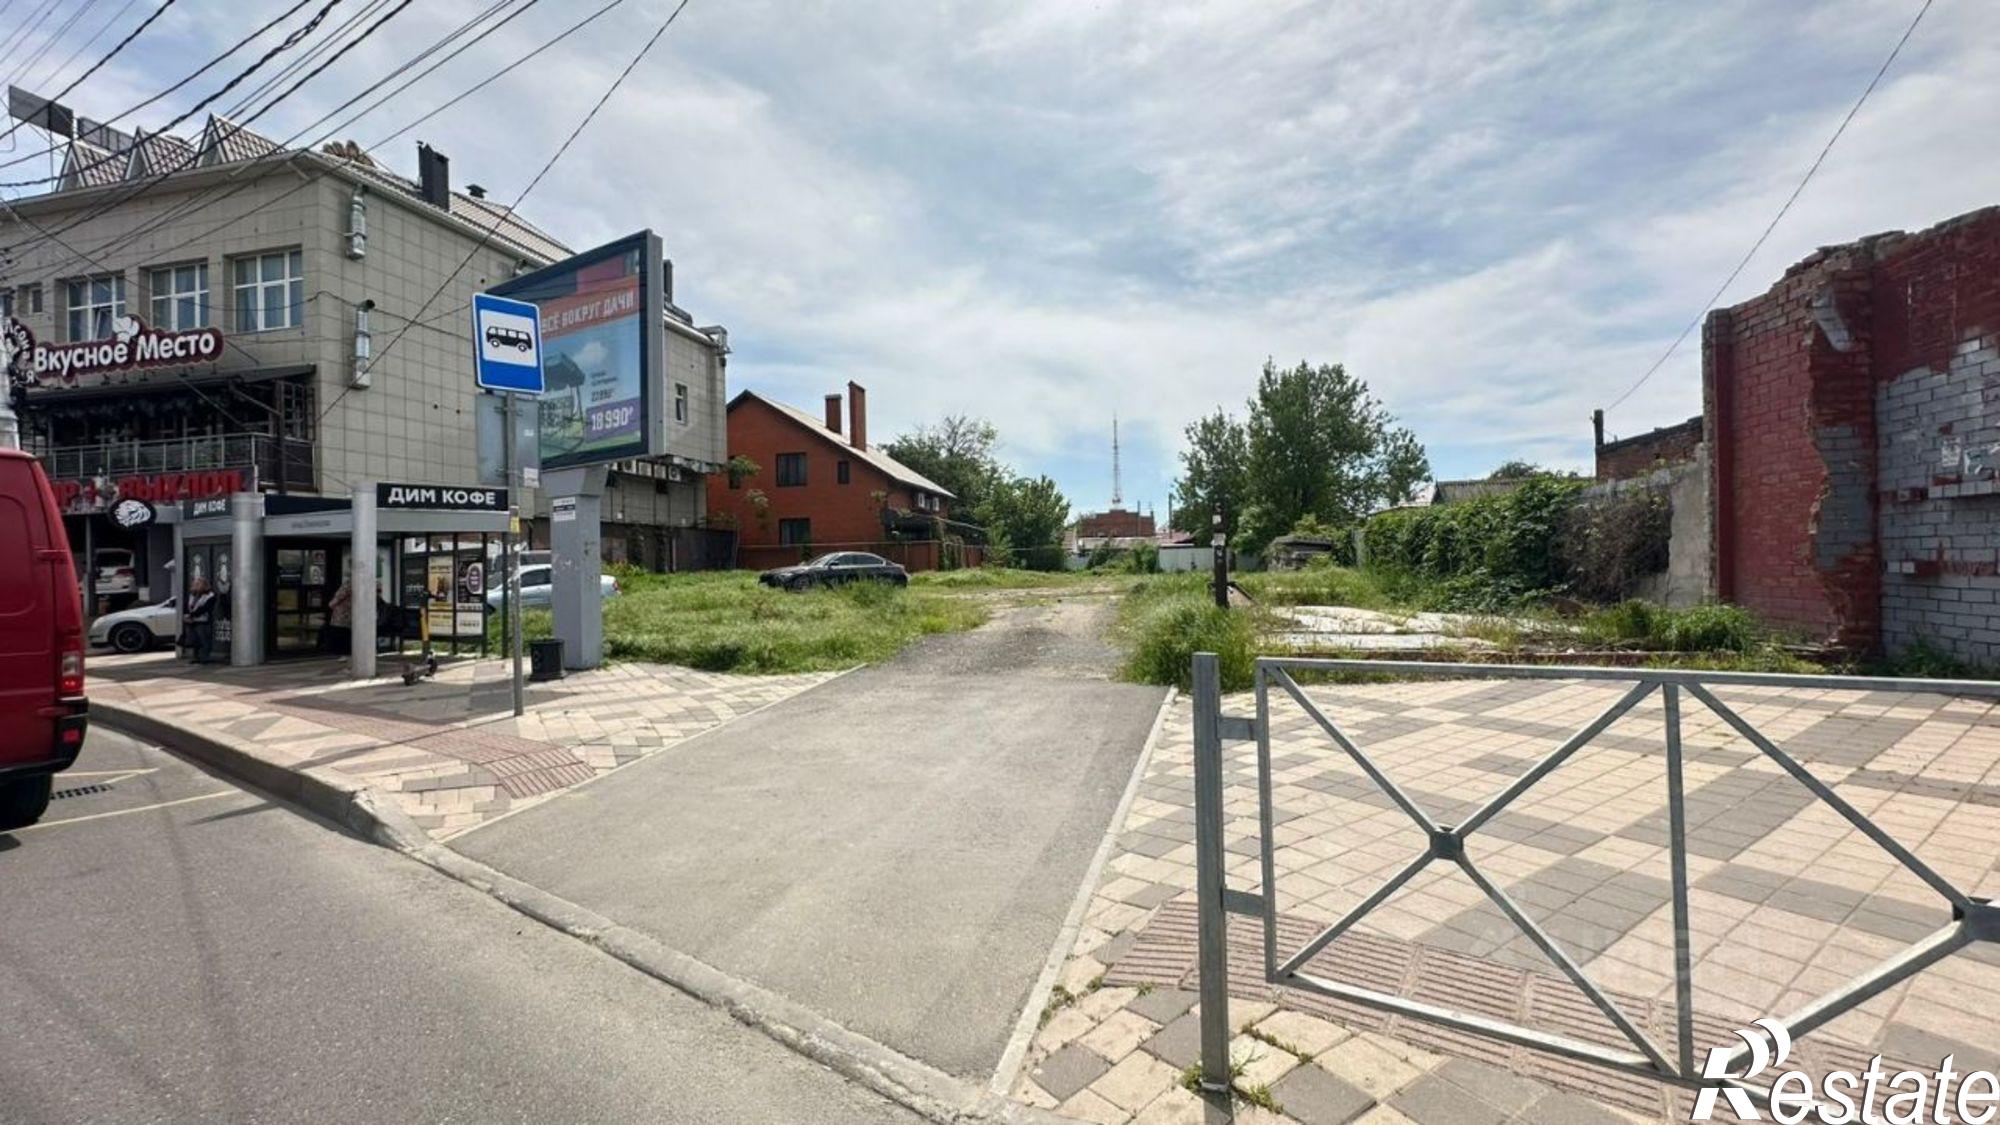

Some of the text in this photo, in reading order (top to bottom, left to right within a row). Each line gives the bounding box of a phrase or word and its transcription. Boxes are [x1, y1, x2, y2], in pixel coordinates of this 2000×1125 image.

[562, 302, 601, 328] ВОКРУГ
[603, 290, 634, 316] ДАЧИ
[34, 343, 128, 376] Вкусное
[136, 333, 215, 362] Место
[388, 487, 496, 505] ДИМ КОФЕ
